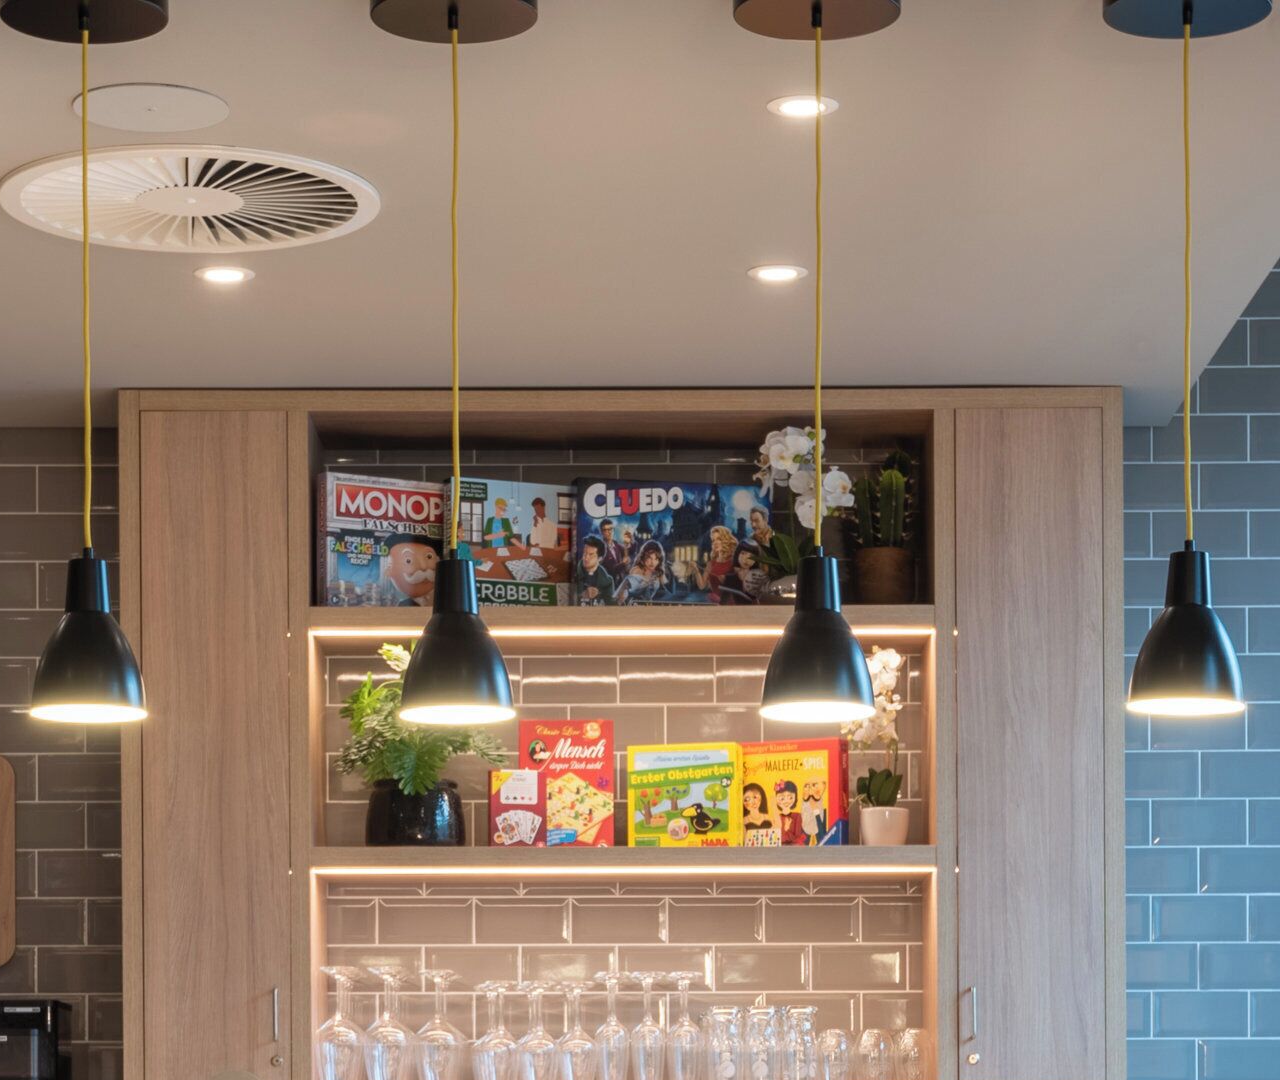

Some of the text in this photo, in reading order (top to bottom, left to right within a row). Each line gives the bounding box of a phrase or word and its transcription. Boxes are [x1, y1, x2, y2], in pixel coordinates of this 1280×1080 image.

[340, 488, 443, 522] MONOP
[583, 482, 684, 519] CLUEDO
[362, 518, 428, 535] FALSCHES
[330, 541, 389, 556] FALSCHGELD
[476, 583, 550, 602] CRABBLE
[549, 737, 606, 762] Mensch
[630, 773, 666, 784] Erster
[668, 765, 733, 781] Obstgarten
[701, 838, 729, 847] HABA
